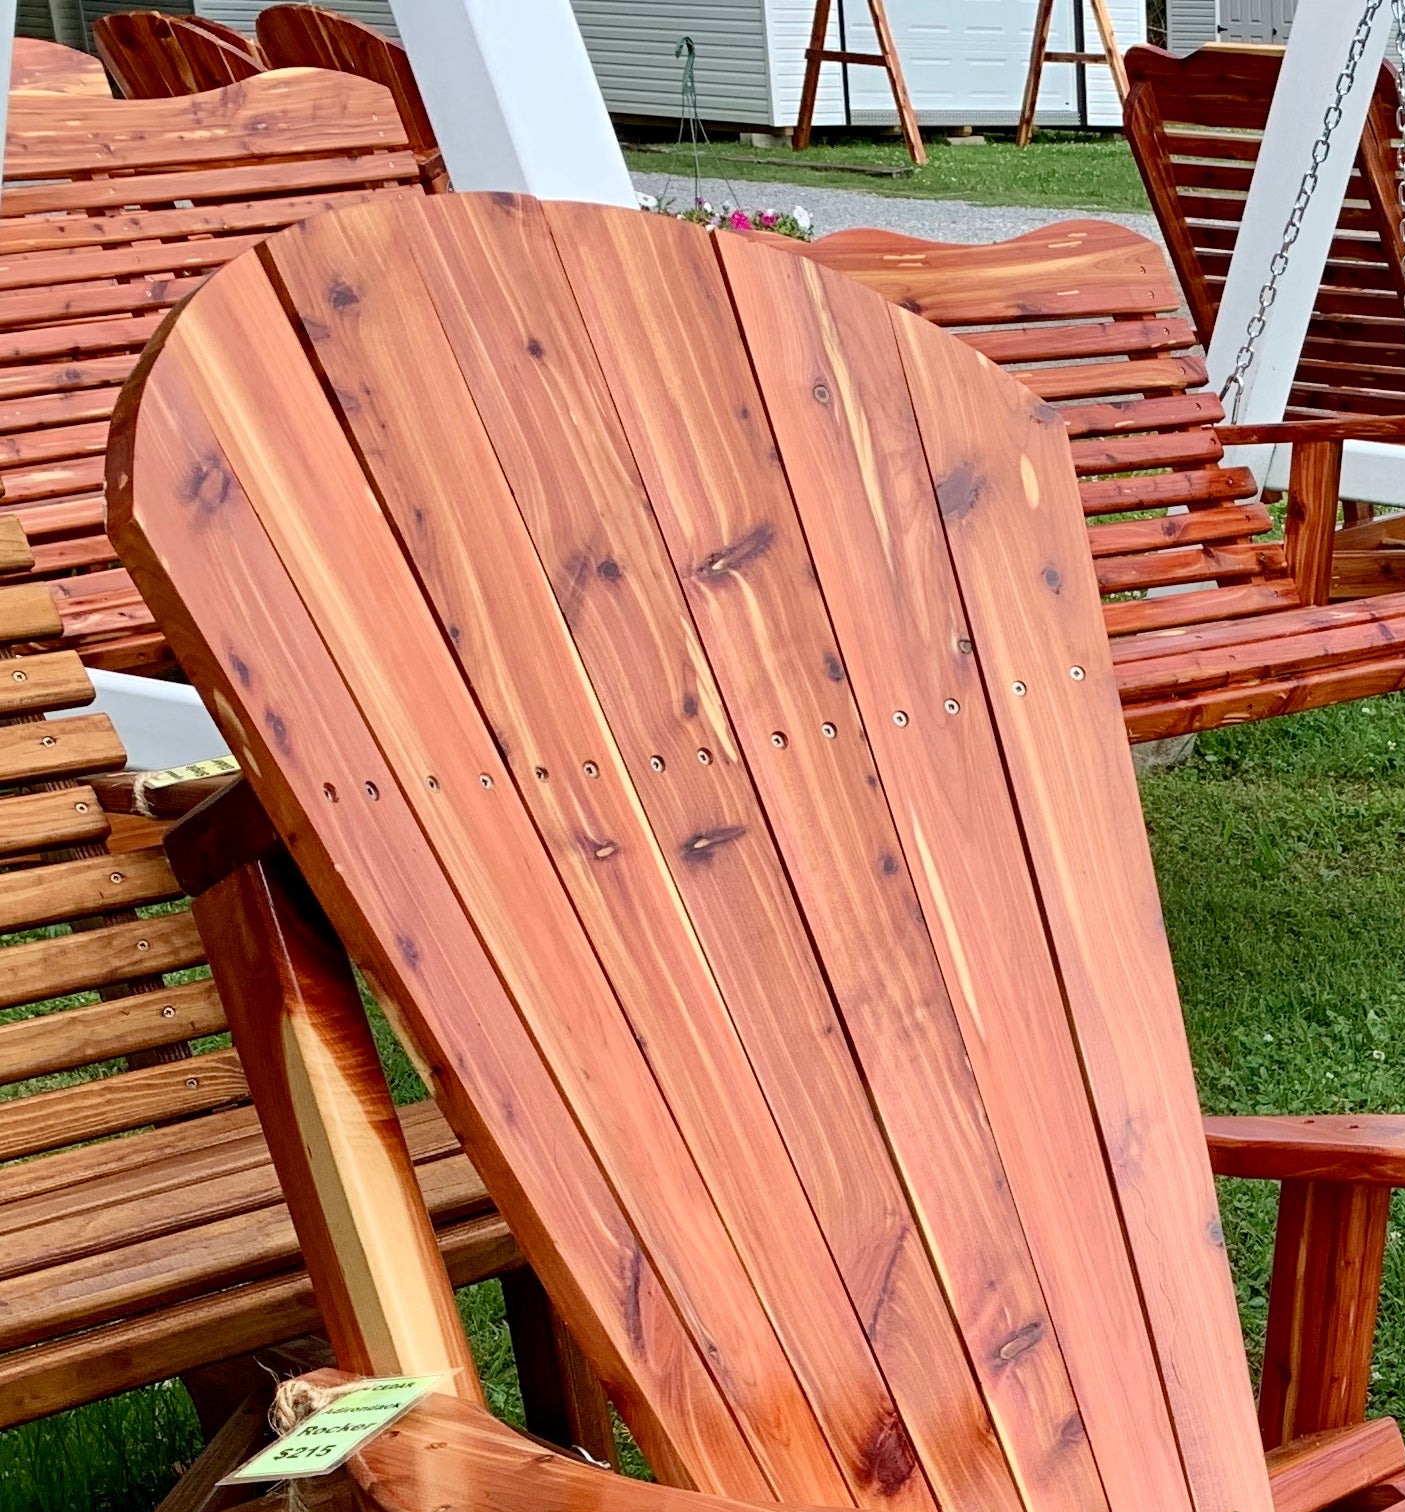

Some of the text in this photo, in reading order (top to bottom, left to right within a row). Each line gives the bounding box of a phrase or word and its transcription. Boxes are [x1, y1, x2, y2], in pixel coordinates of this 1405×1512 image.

[372, 1382, 416, 1391] CEDAR
[321, 1402, 401, 1415] Adirondack
[296, 1422, 378, 1437] Rocker
[273, 1444, 337, 1460] $215
